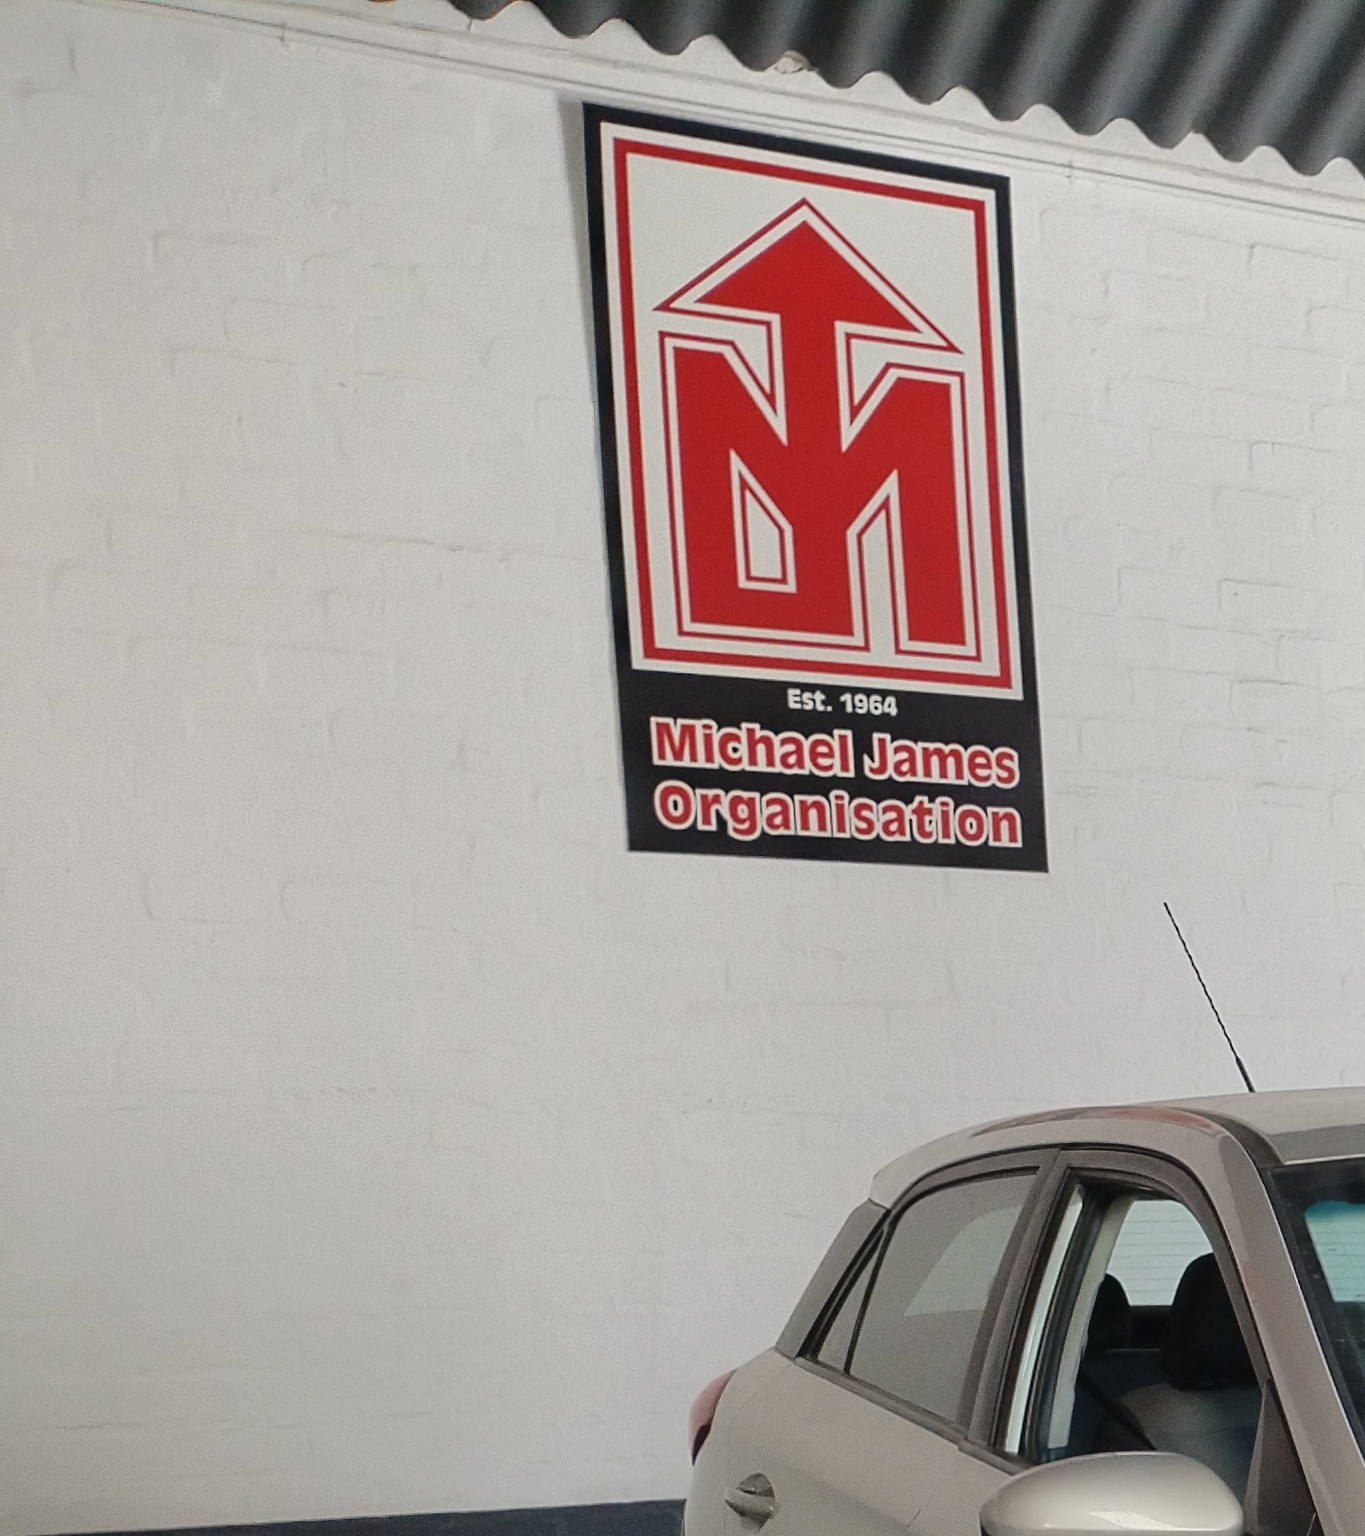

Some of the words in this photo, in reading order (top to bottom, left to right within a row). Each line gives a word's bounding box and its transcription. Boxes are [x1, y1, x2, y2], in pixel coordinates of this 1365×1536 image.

[786, 687, 834, 712] Est.
[839, 692, 898, 715] 1964
[650, 716, 855, 778] Michael
[863, 732, 1020, 789] James
[654, 780, 1023, 848] Organisation
